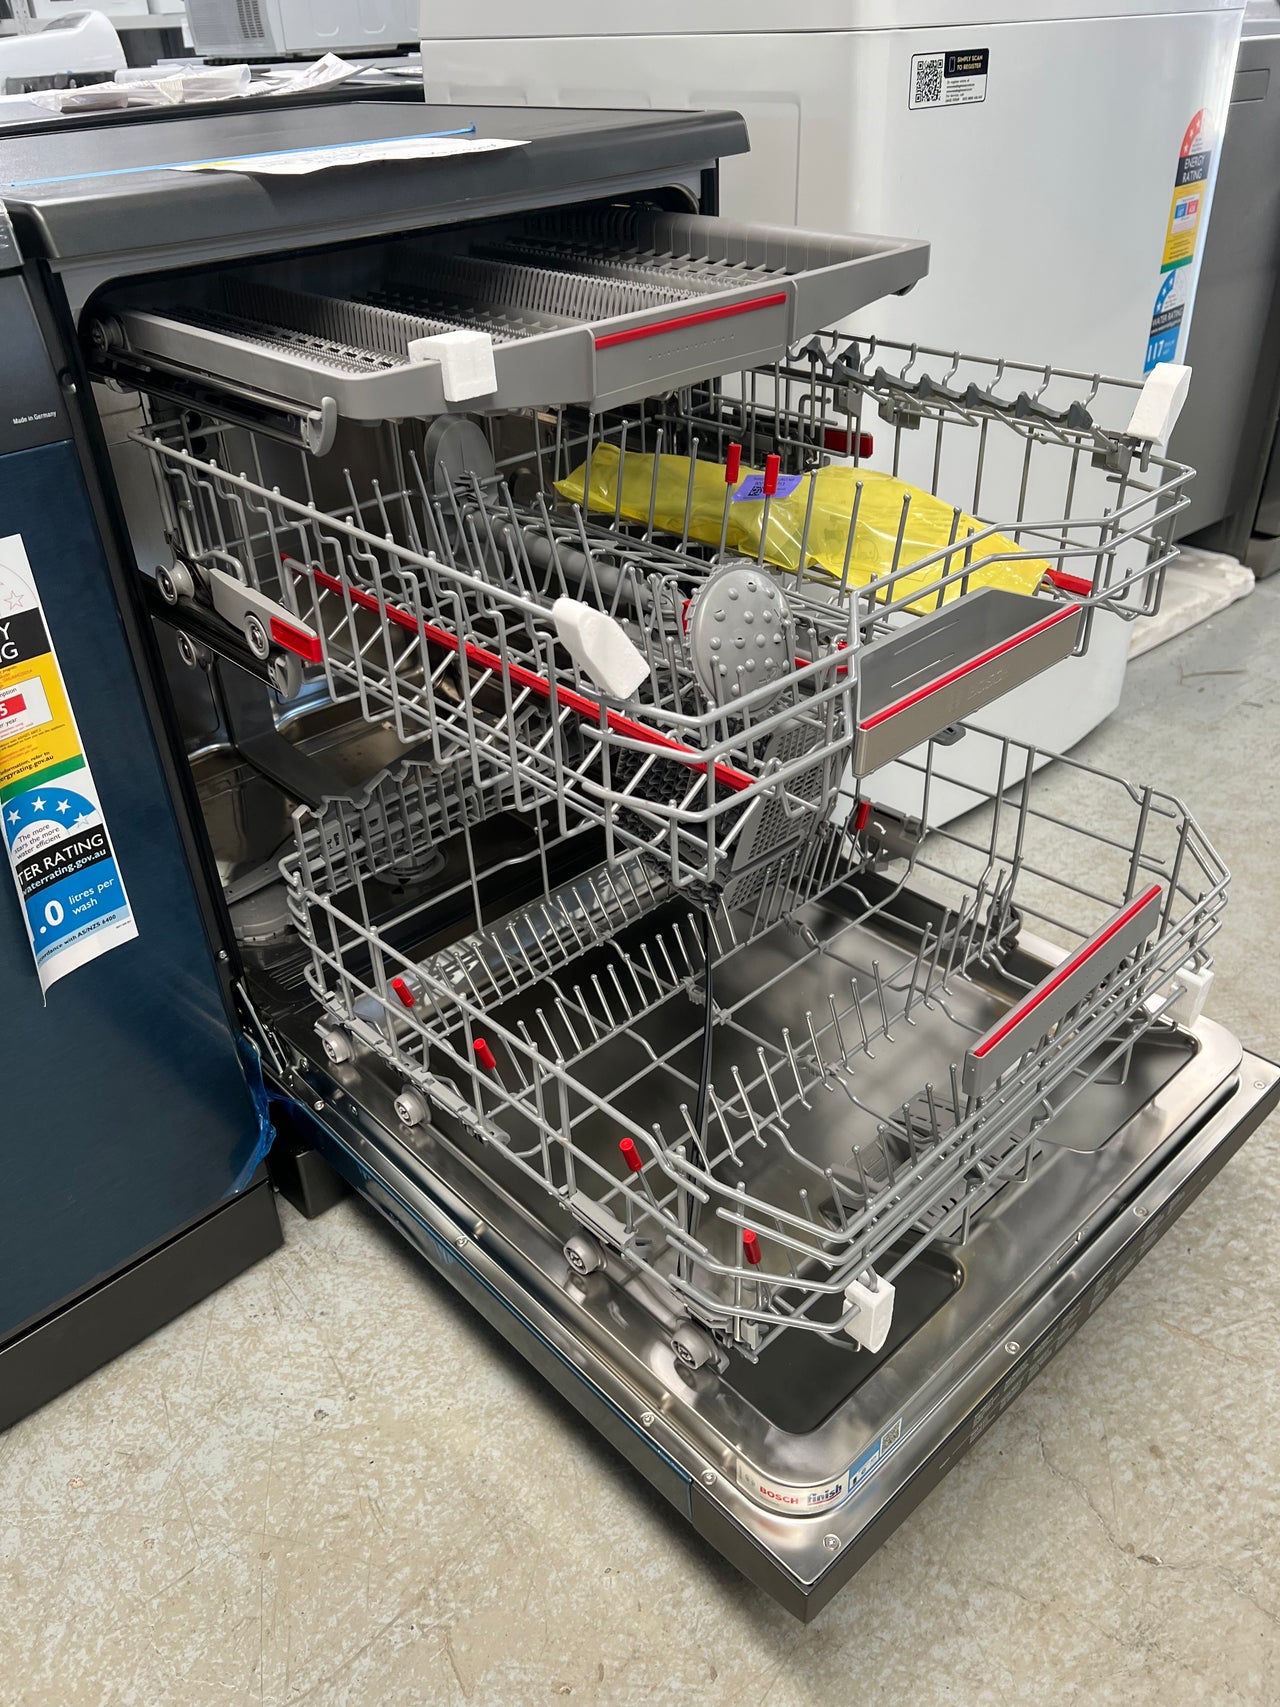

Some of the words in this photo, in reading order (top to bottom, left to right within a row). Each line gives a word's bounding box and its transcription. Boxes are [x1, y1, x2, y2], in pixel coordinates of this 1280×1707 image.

[1184, 154, 1206, 169] ENERGY
[1182, 168, 1203, 183] RATING
[12, 416, 28, 425] Made
[34, 411, 56, 420] Germany
[14, 842, 28, 854] stars
[30, 836, 41, 845] the
[42, 827, 60, 839] more
[18, 834, 31, 843] The
[32, 824, 50, 836] more
[17, 847, 34, 860] water
[36, 833, 61, 849] efficient
[43, 833, 104, 871] RATING
[69, 887, 95, 905] litres
[97, 878, 115, 894] per
[72, 897, 98, 916] wash
[64, 934, 77, 945] with
[77, 921, 101, 938] AS/NZS
[102, 914, 117, 925] 6400
[759, 1485, 799, 1505] BOSCH
[807, 1483, 843, 1504] finish
